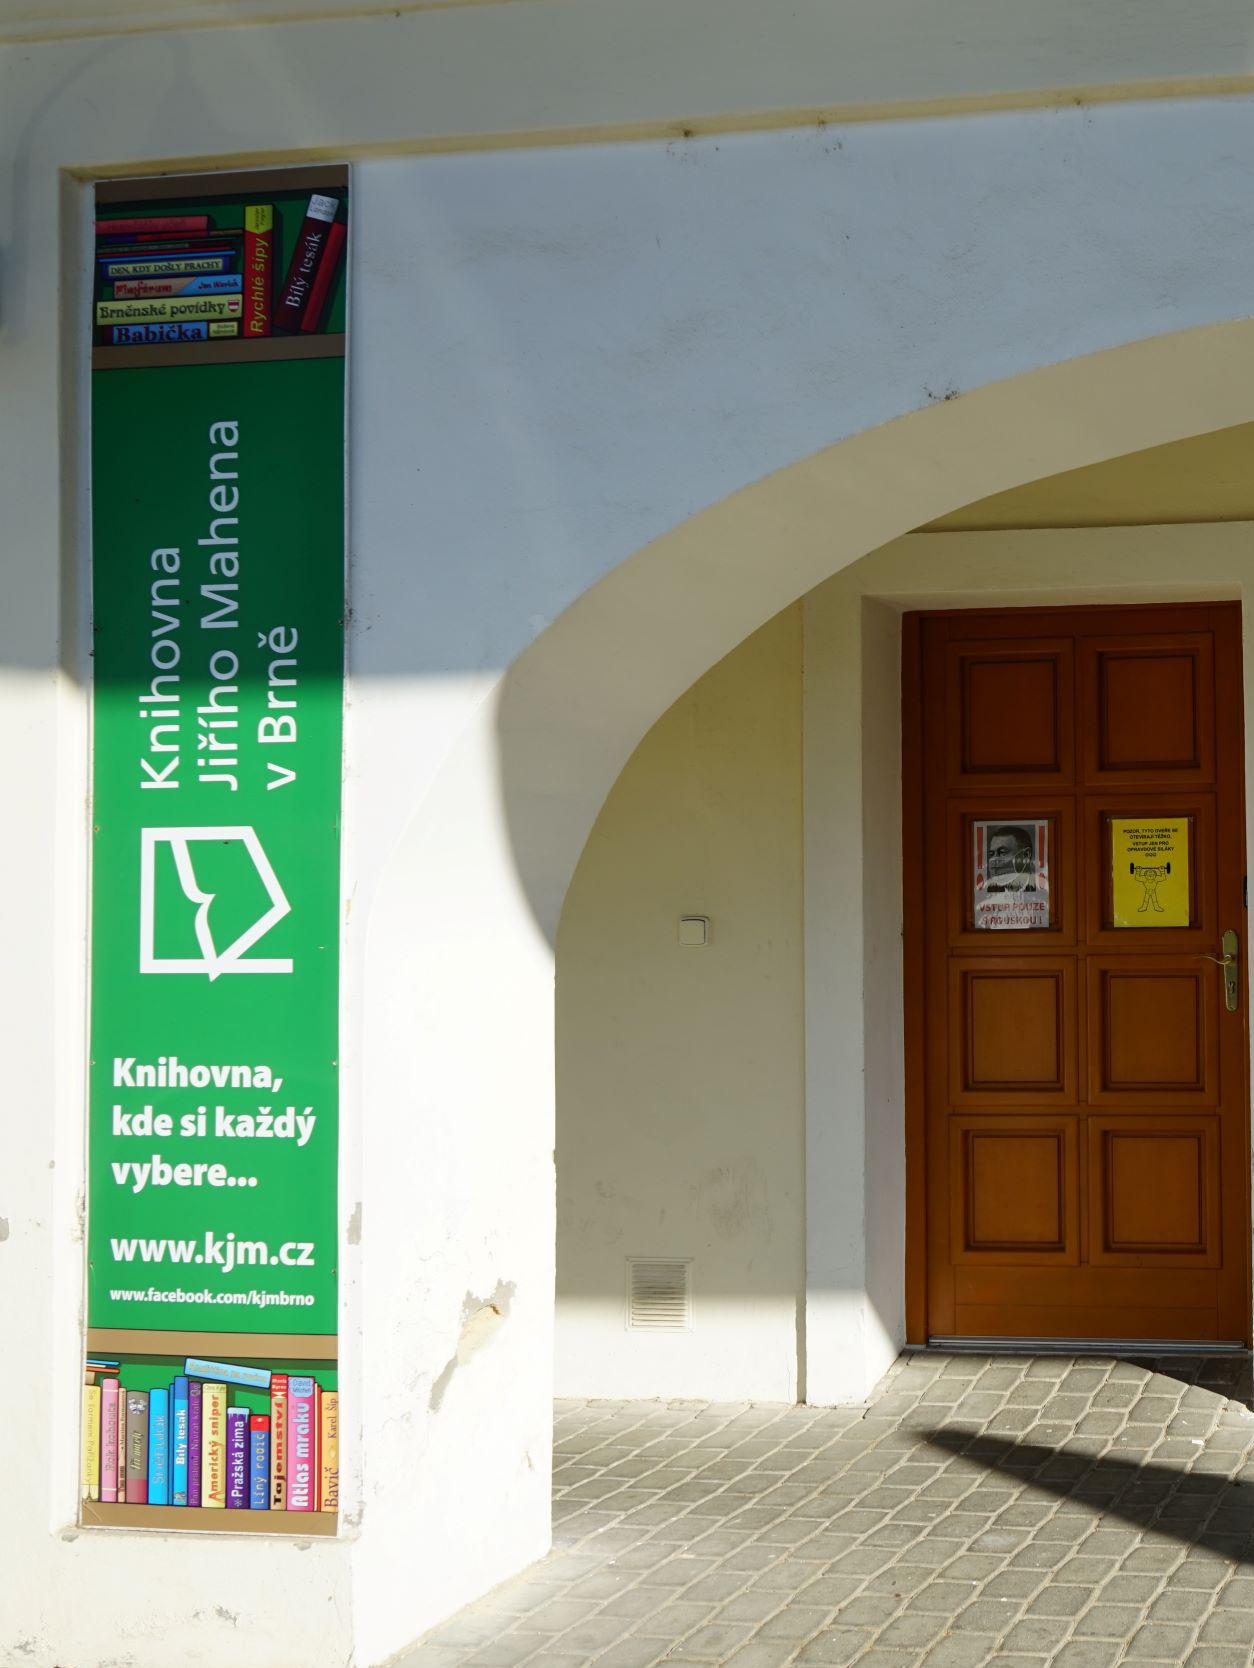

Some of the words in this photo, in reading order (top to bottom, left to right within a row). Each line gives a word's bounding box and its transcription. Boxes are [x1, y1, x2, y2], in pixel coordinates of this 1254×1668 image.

[184, 260, 221, 271] PRACHY
[251, 237, 269, 271] šípy
[285, 276, 309, 308] Bílý
[299, 232, 323, 272] tesák
[99, 303, 166, 319] Brněnské
[170, 301, 226, 317] povídky
[250, 276, 267, 333] Rychlé
[115, 324, 203, 343] Babička
[198, 420, 239, 629] Mahena
[139, 547, 181, 789] Knihovna
[257, 626, 299, 743] Brně
[197, 650, 239, 791] Jiřího
[267, 762, 297, 791] v
[113, 1056, 283, 1093] Knihovna,
[112, 1105, 173, 1137] kde
[180, 1105, 207, 1137] si
[214, 1105, 316, 1147] každý
[111, 1154, 258, 1194] vybere...
[110, 1231, 315, 1273] www.kjm.cz
[110, 1287, 315, 1309] www.facebook.com/kjmbrno
[209, 1395, 220, 1435] sniper
[231, 1420, 244, 1449] zima
[290, 1402, 309, 1458] mraků
[327, 1415, 337, 1439] Karel
[254, 1433, 265, 1469] rodič
[208, 1441, 224, 1504] Americký
[231, 1451, 244, 1497] Pražská
[254, 1476, 267, 1504] Líný
[291, 1463, 309, 1507] Atlas
[324, 1467, 338, 1508] Bavič
